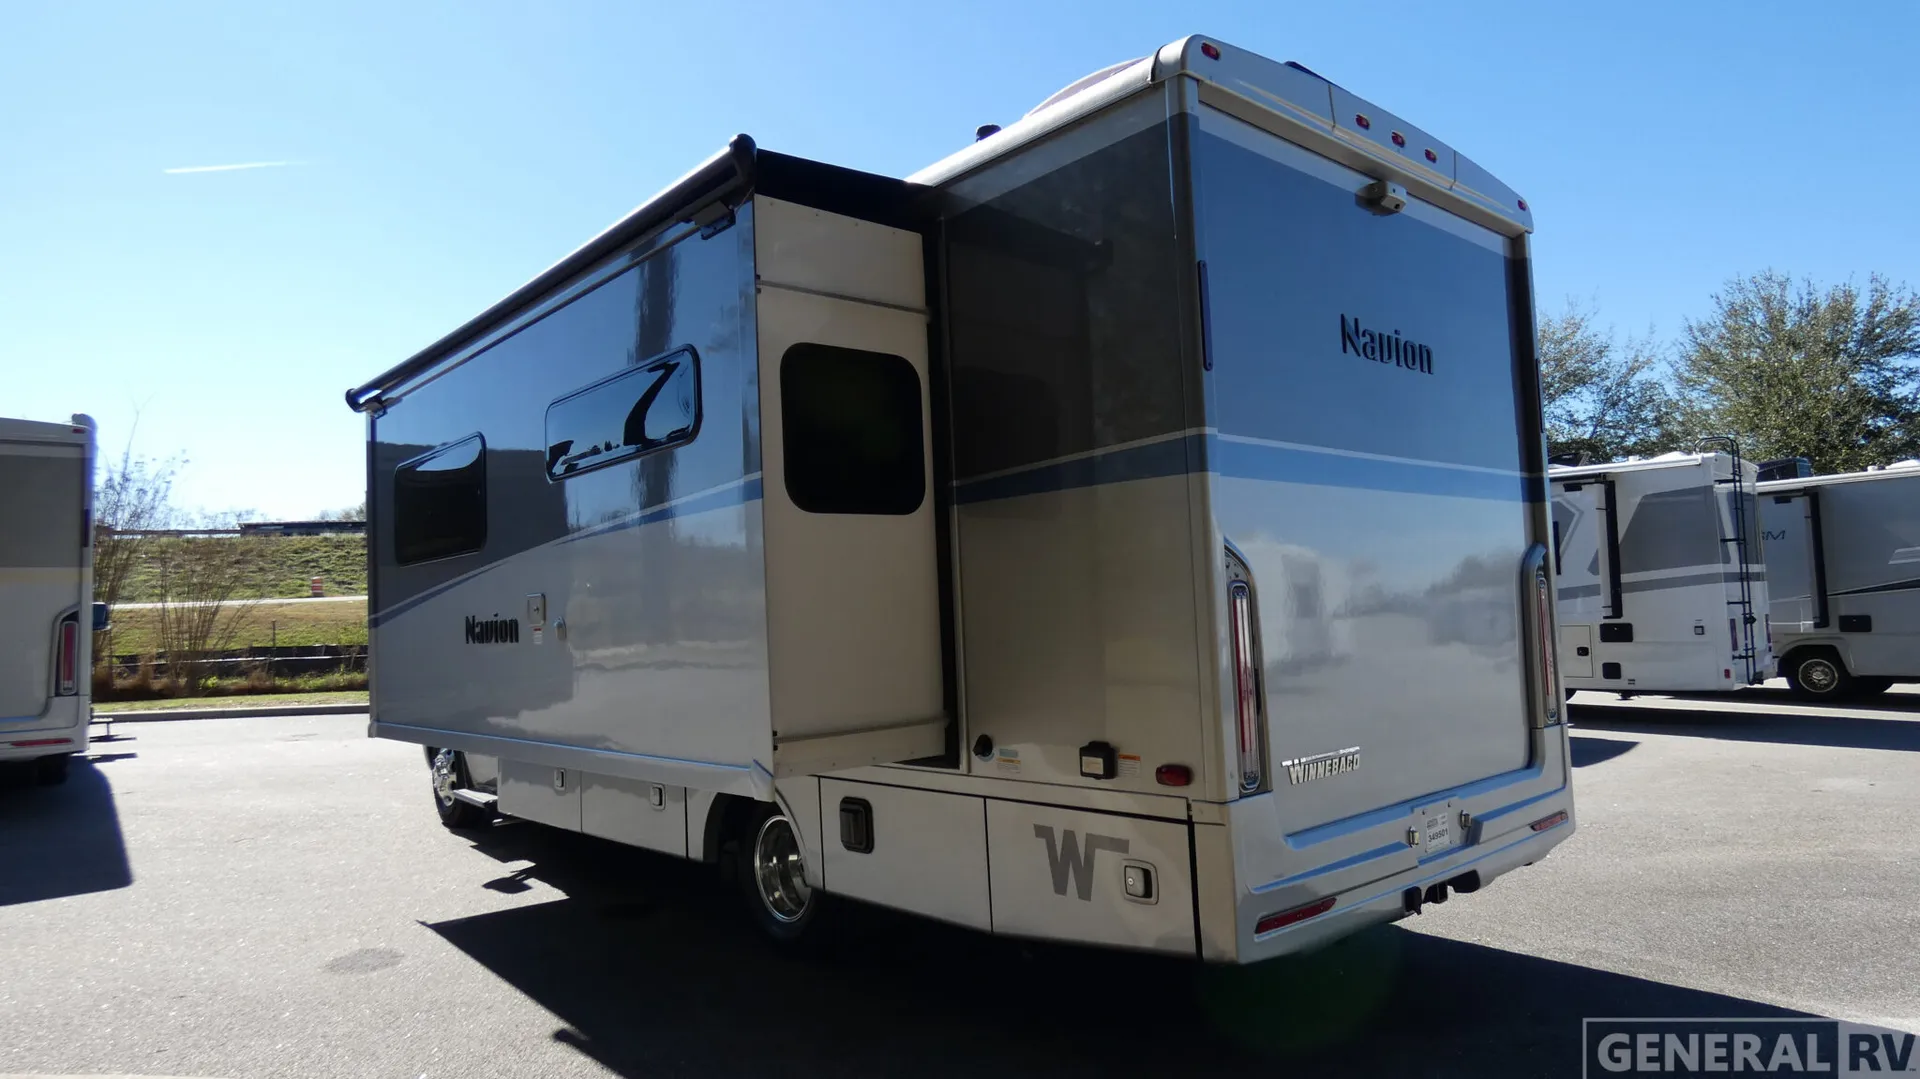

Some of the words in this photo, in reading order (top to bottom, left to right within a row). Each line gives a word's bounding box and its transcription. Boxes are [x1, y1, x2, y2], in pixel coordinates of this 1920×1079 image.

[1340, 313, 1434, 375] Navion
[465, 613, 520, 644] Navion
[1281, 746, 1361, 785] WINNEBAGO
